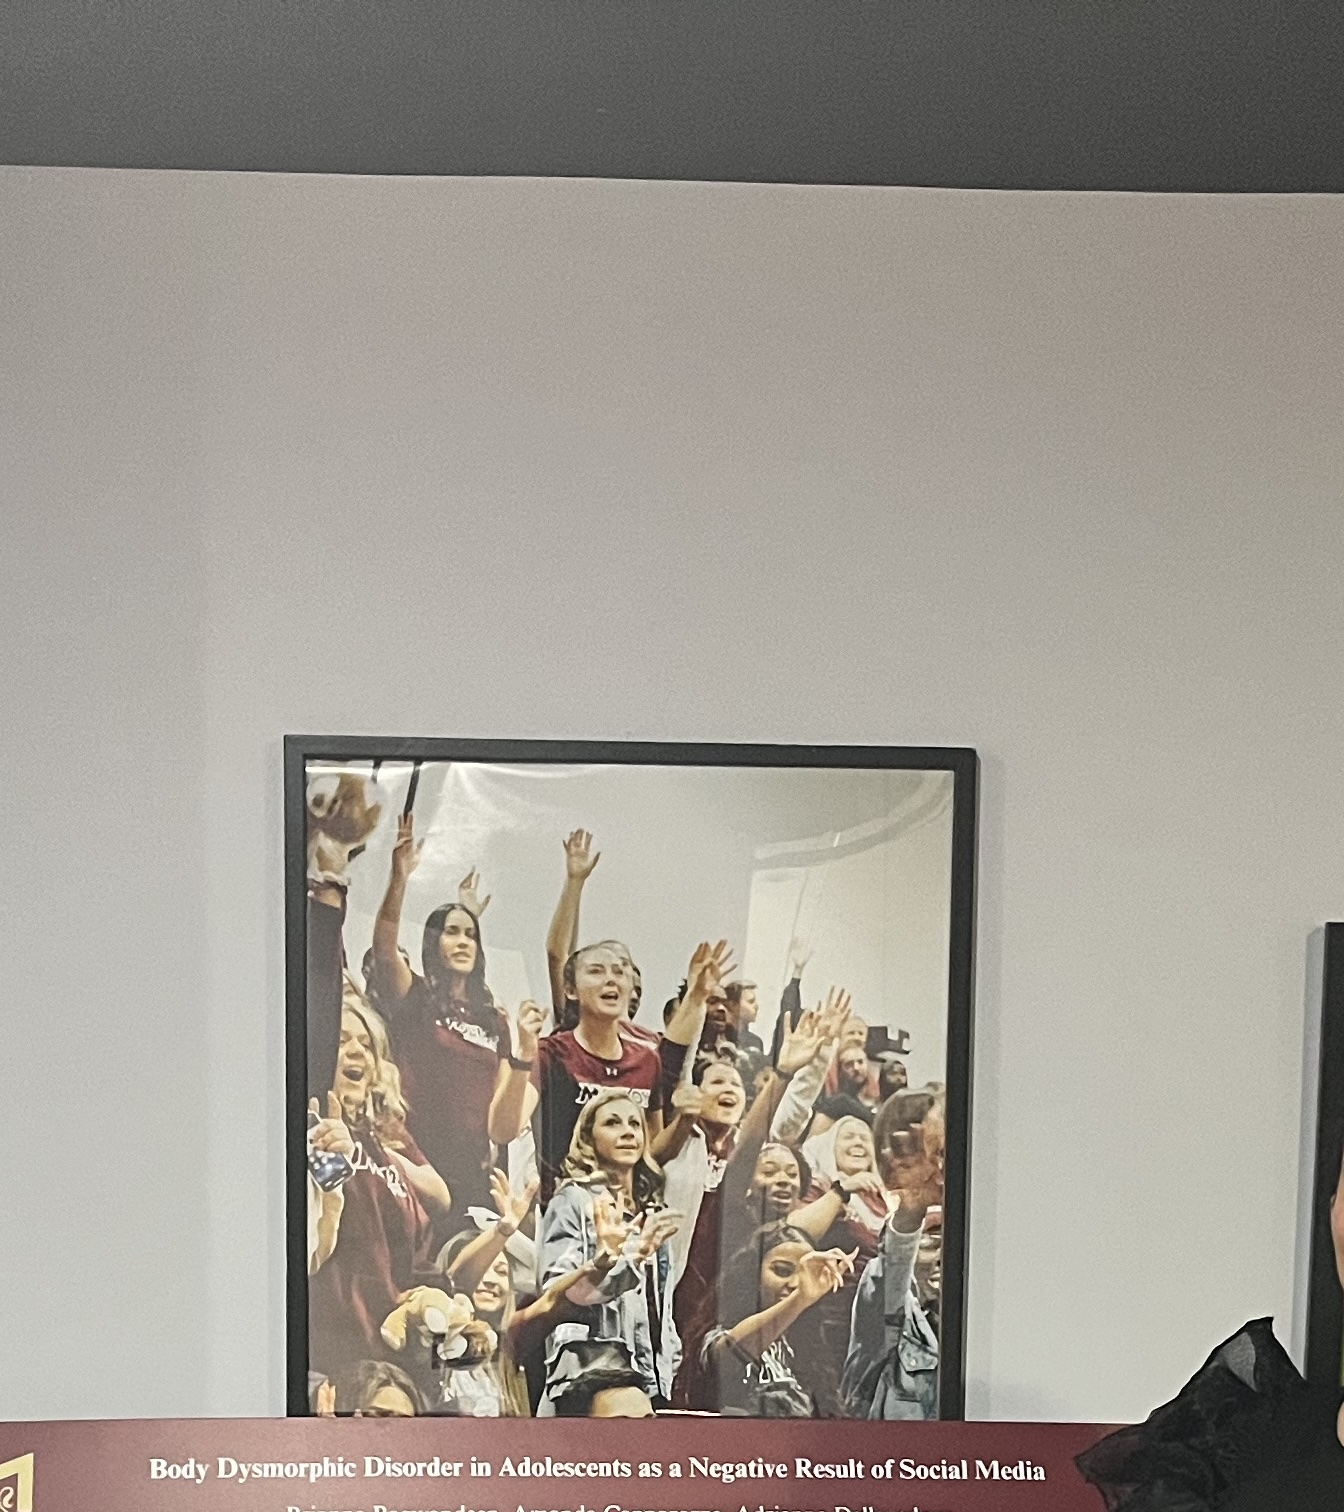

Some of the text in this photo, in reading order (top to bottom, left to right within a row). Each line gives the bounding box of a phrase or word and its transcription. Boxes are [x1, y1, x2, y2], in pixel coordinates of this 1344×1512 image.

[149, 1457, 1045, 1484] Body Dysmorphic Disorder in Adolescents as a Negative Result of Social Media
